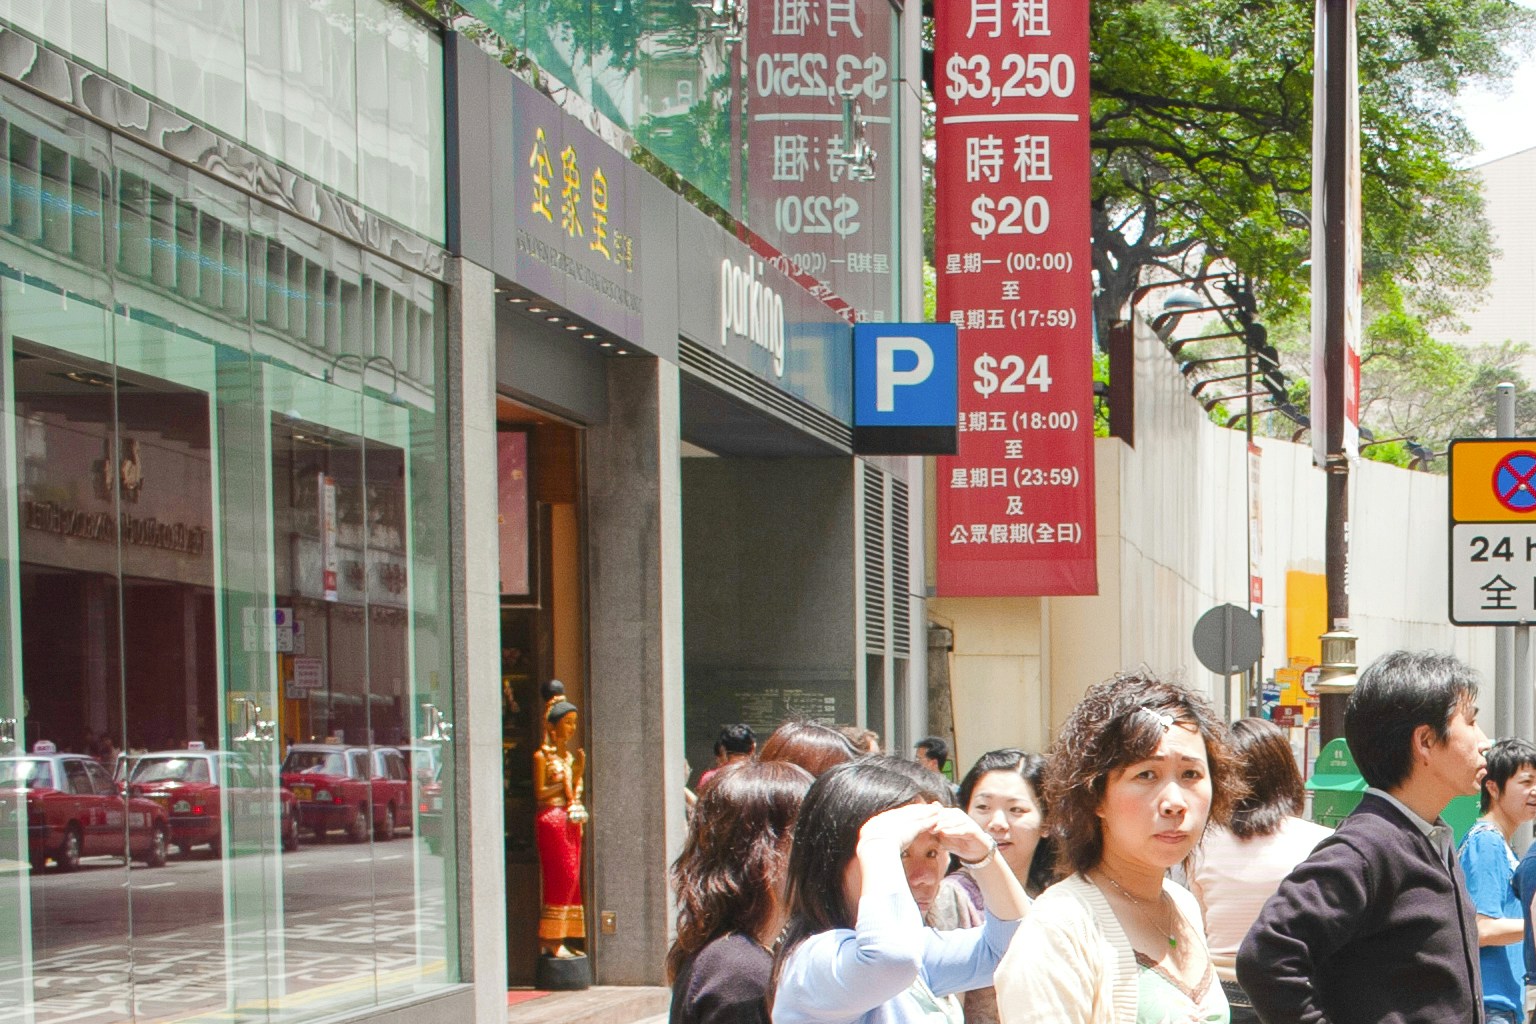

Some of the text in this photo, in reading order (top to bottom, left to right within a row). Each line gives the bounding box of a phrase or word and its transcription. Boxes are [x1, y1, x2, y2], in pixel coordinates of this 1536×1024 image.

[966, 0, 1051, 39] 月租
[945, 52, 1076, 107] $3,250
[966, 134, 1053, 183] 時租
[970, 193, 1050, 240] $20
[945, 251, 1073, 274] 星期一 (00:00)
[1001, 280, 1021, 301] 至
[721, 255, 785, 378] parking
[950, 308, 1077, 331] 星期五 (17:59)
[876, 337, 935, 412] P
[973, 352, 1053, 399] $24
[1012, 410, 1079, 432] (18:00)
[1004, 439, 1024, 459] 至
[951, 466, 1080, 489] 星期日 (23:59)
[1005, 495, 1025, 516] 及
[1470, 536, 1514, 562] 24
